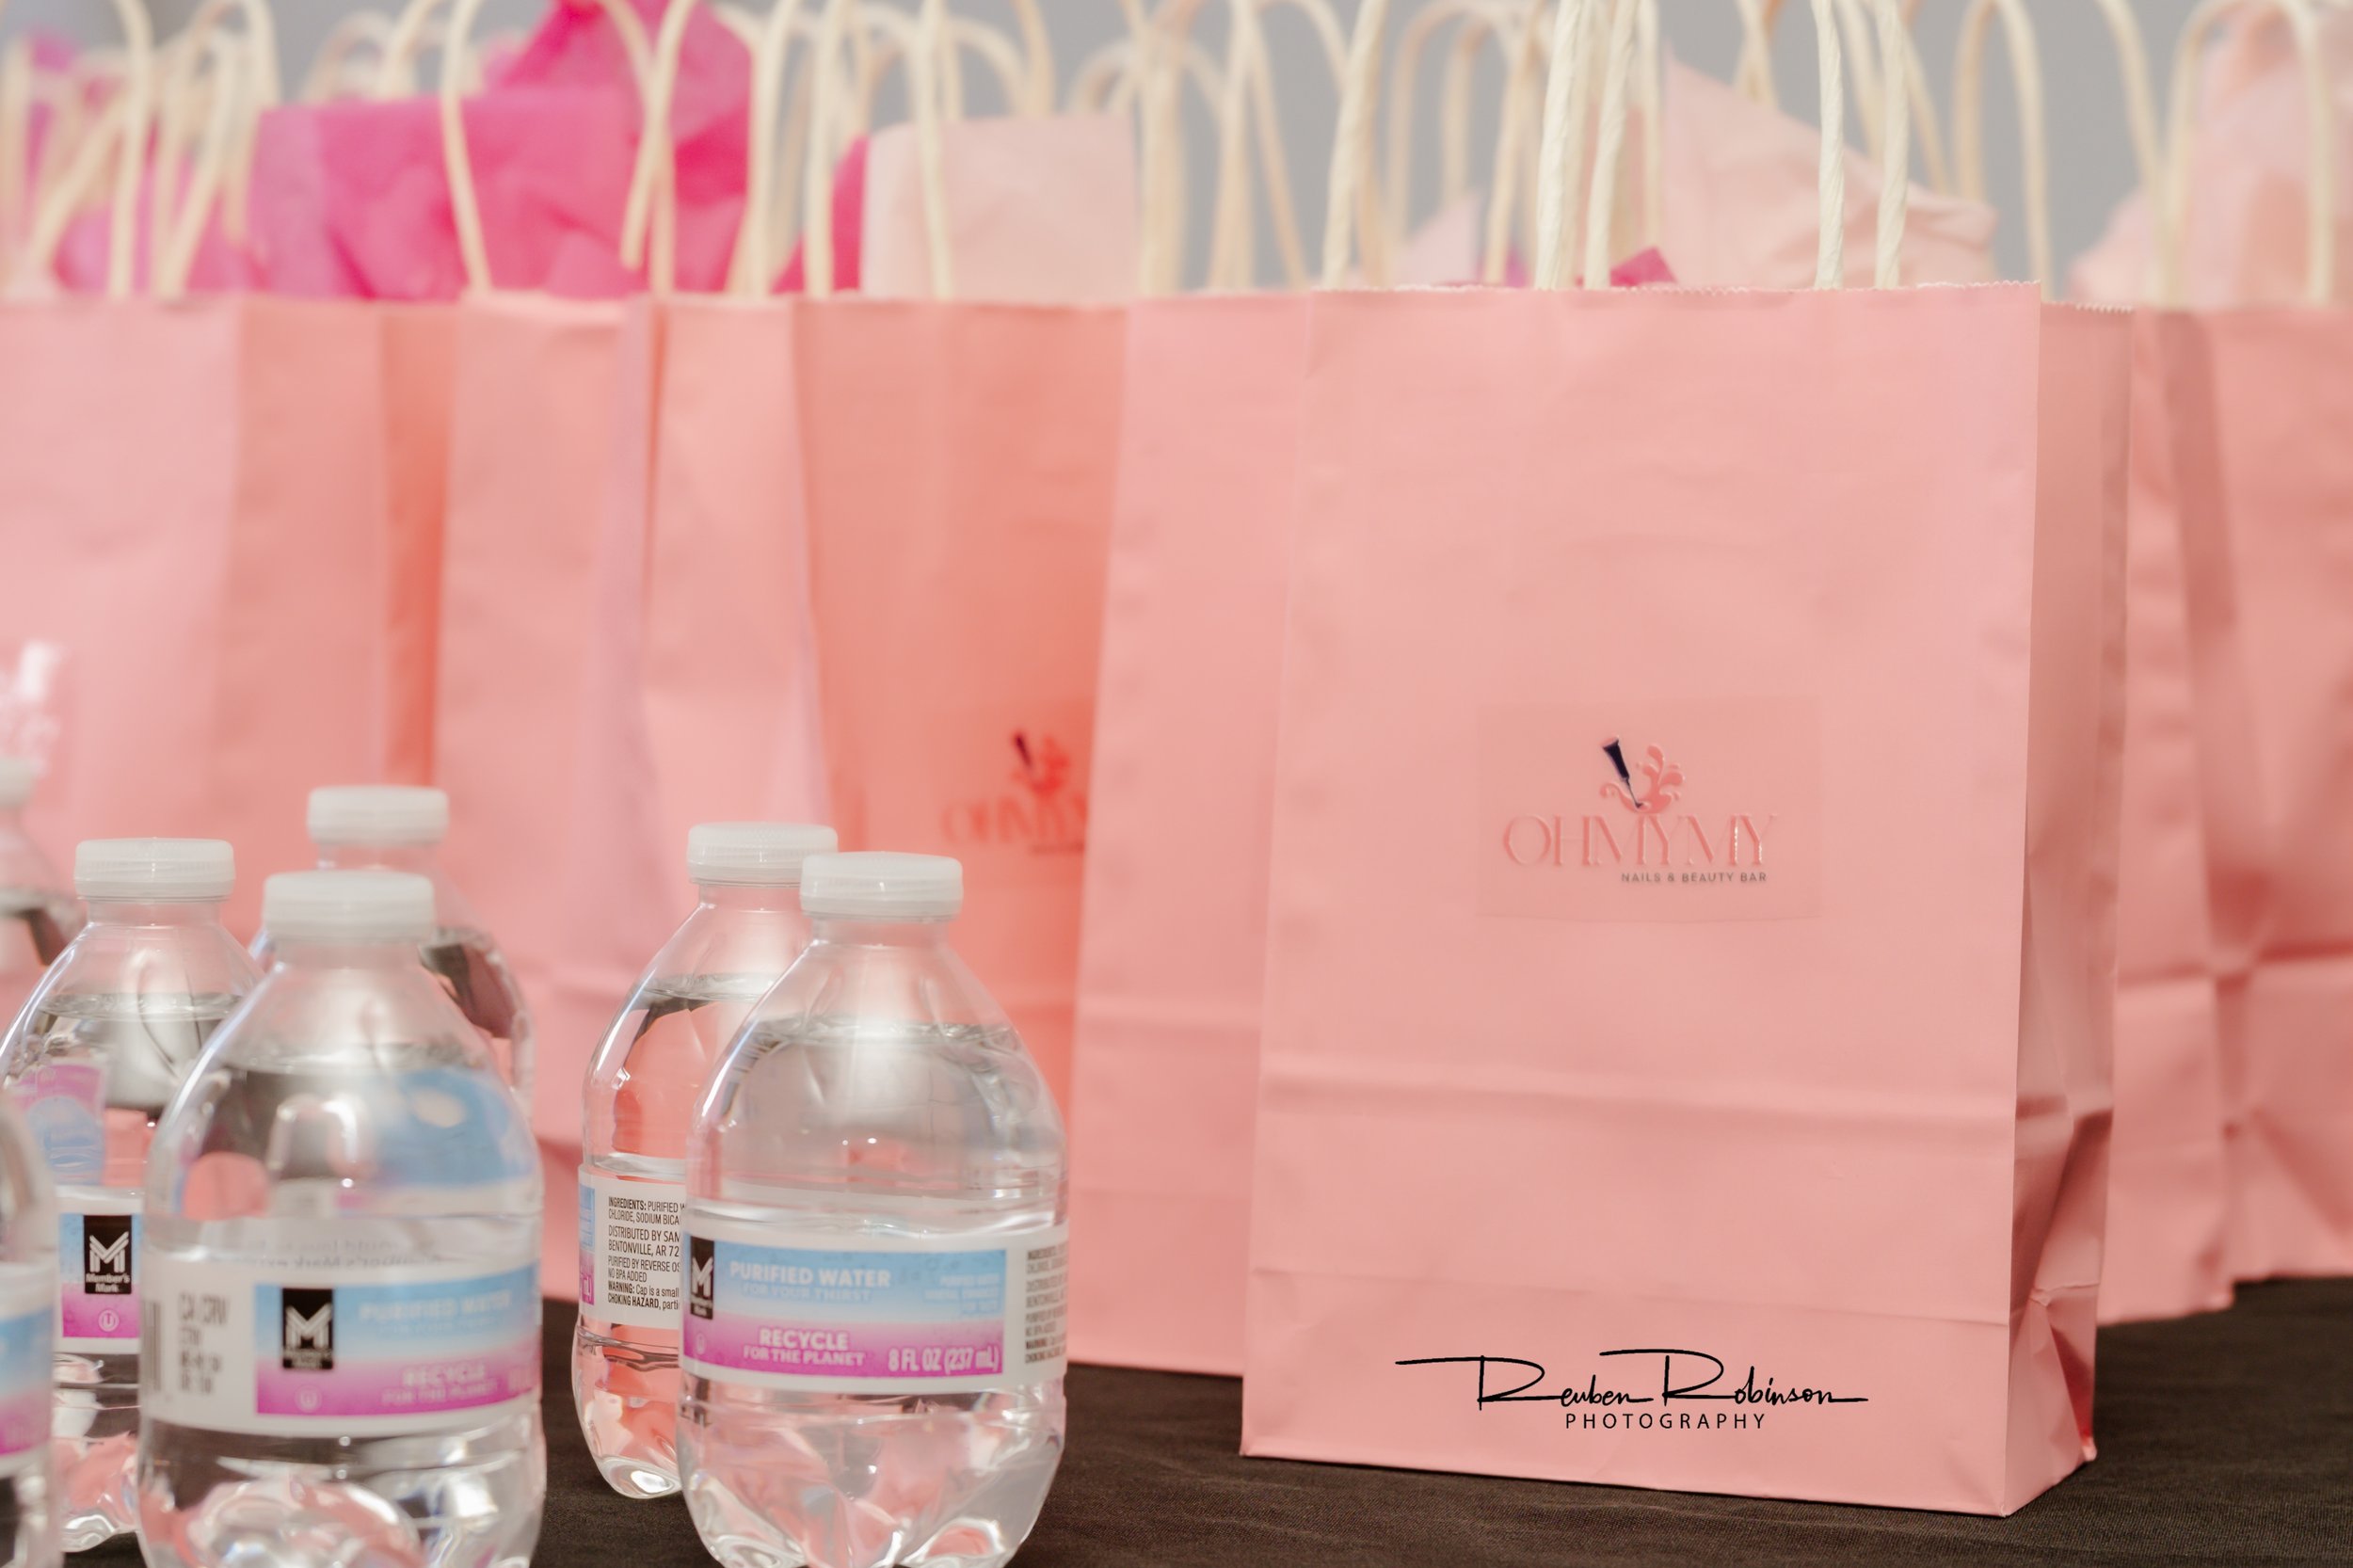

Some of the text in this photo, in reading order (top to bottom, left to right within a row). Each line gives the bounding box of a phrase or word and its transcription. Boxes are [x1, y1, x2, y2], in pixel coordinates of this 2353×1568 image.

[1621, 872, 1768, 883] NAILS & BEAUTY BAR
[608, 1196, 647, 1211] INGREDIENTS:
[648, 1200, 679, 1213] PURIFIED
[608, 1208, 635, 1224] CHLORIDE,
[636, 1212, 662, 1224] SODIUM
[608, 1224, 649, 1241] DISTRIBUTED
[651, 1230, 662, 1241] BY
[608, 1239, 680, 1257] BENTONVILLE, AR 72
[608, 1255, 631, 1269] PURIFIED
[632, 1258, 640, 1270] BY
[640, 1259, 670, 1272] REVERSE
[86, 1272, 131, 1284] Member's
[608, 1268, 648, 1283] NO BPA ADDED
[729, 1261, 891, 1288] PURIFIED WATER
[95, 1283, 119, 1293] Mark
[608, 1280, 635, 1294] WARNING:
[636, 1285, 648, 1297] Cap
[649, 1286, 654, 1296] is
[662, 1287, 680, 1298] small
[744, 1283, 872, 1302] FOR YOUR THIRST
[607, 1293, 632, 1306] CHOKING
[632, 1296, 662, 1310] HAZARD,
[759, 1327, 849, 1351] RECYCLE
[743, 1345, 866, 1366] FOR THE PLANET
[888, 1348, 898, 1372] 8
[901, 1347, 920, 1371] FL
[921, 1346, 941, 1371] OZ
[944, 1346, 975, 1374] (237
[976, 1345, 1000, 1371] mL)
